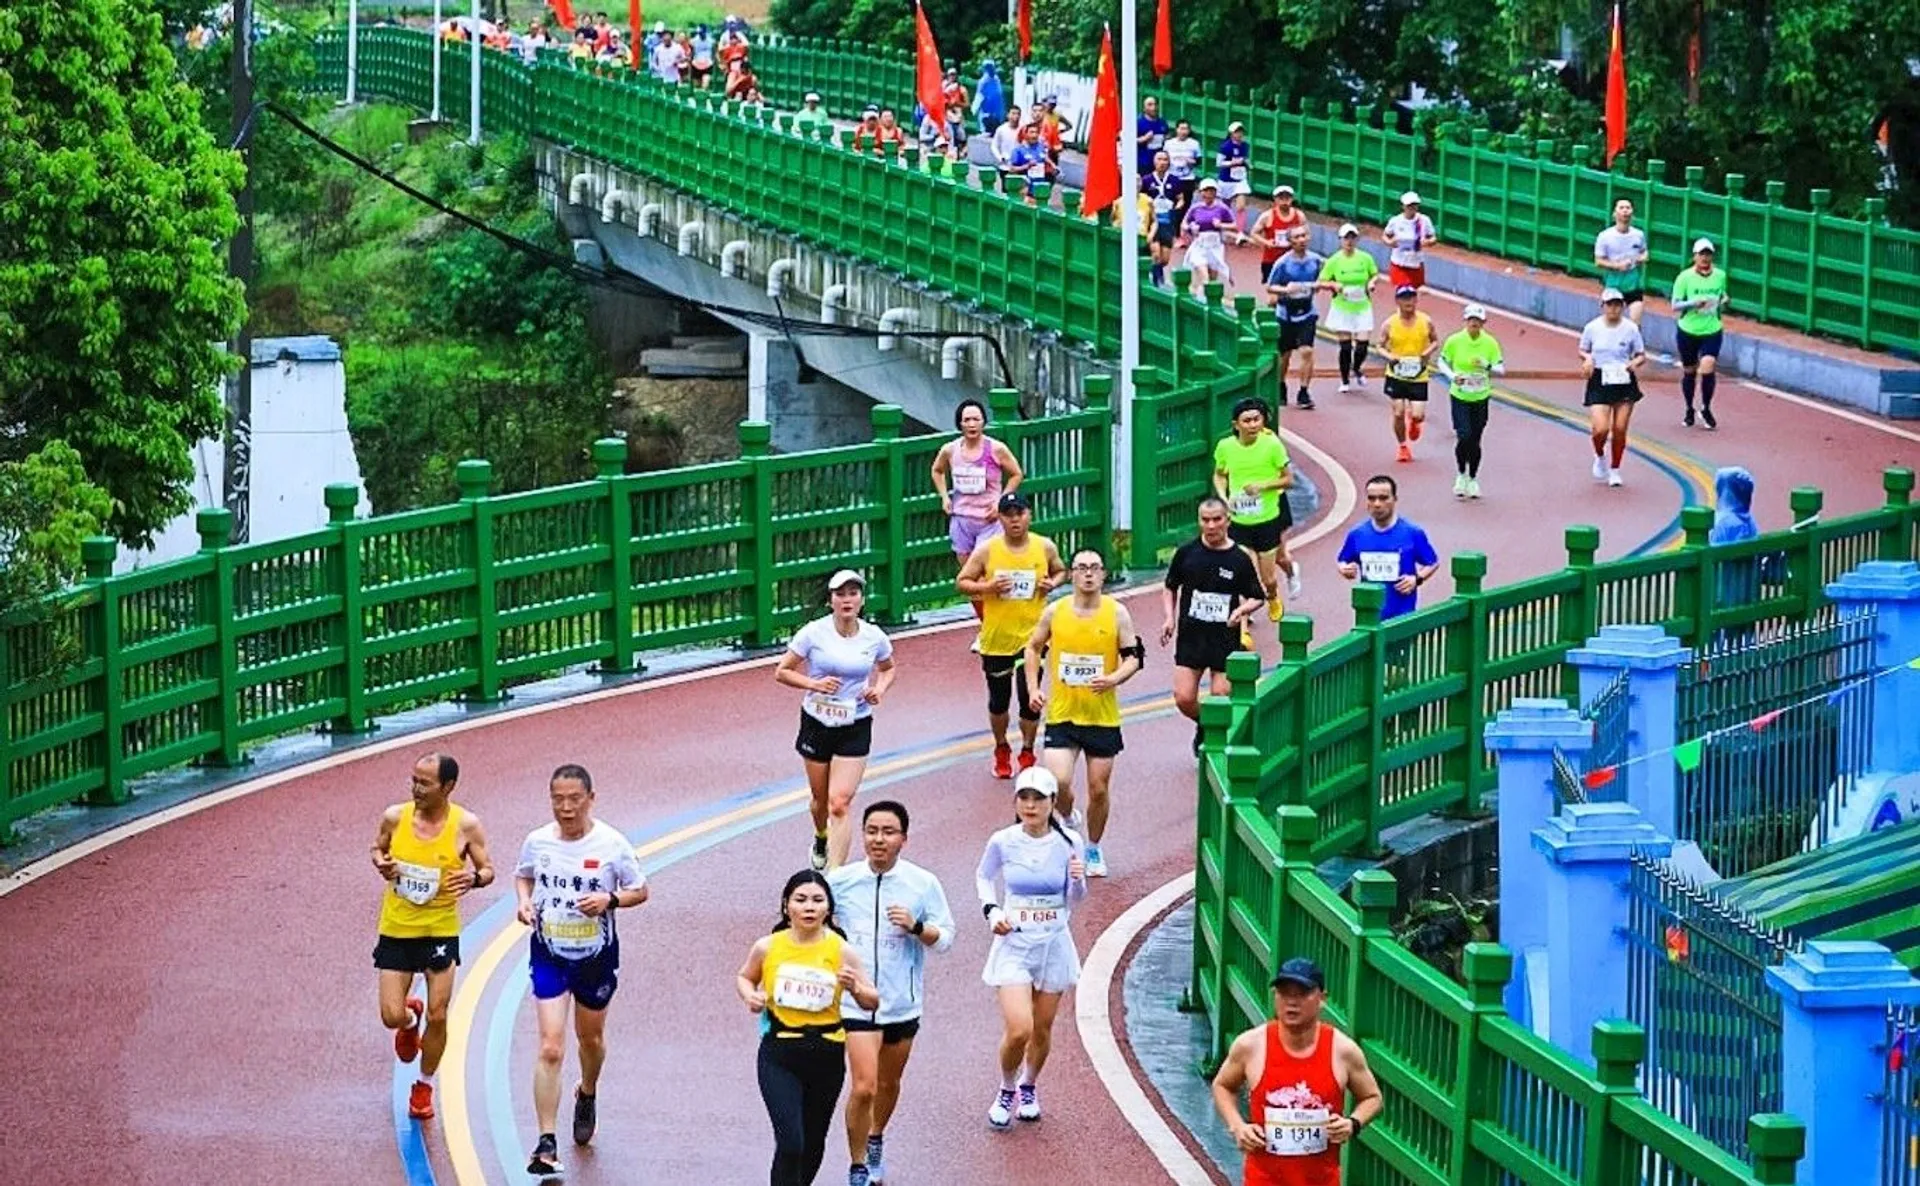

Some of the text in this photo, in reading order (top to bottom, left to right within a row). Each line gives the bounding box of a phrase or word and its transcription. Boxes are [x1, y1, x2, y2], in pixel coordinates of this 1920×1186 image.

[1020, 910, 1027, 922] B
[1274, 1126, 1321, 1141] B 1314
